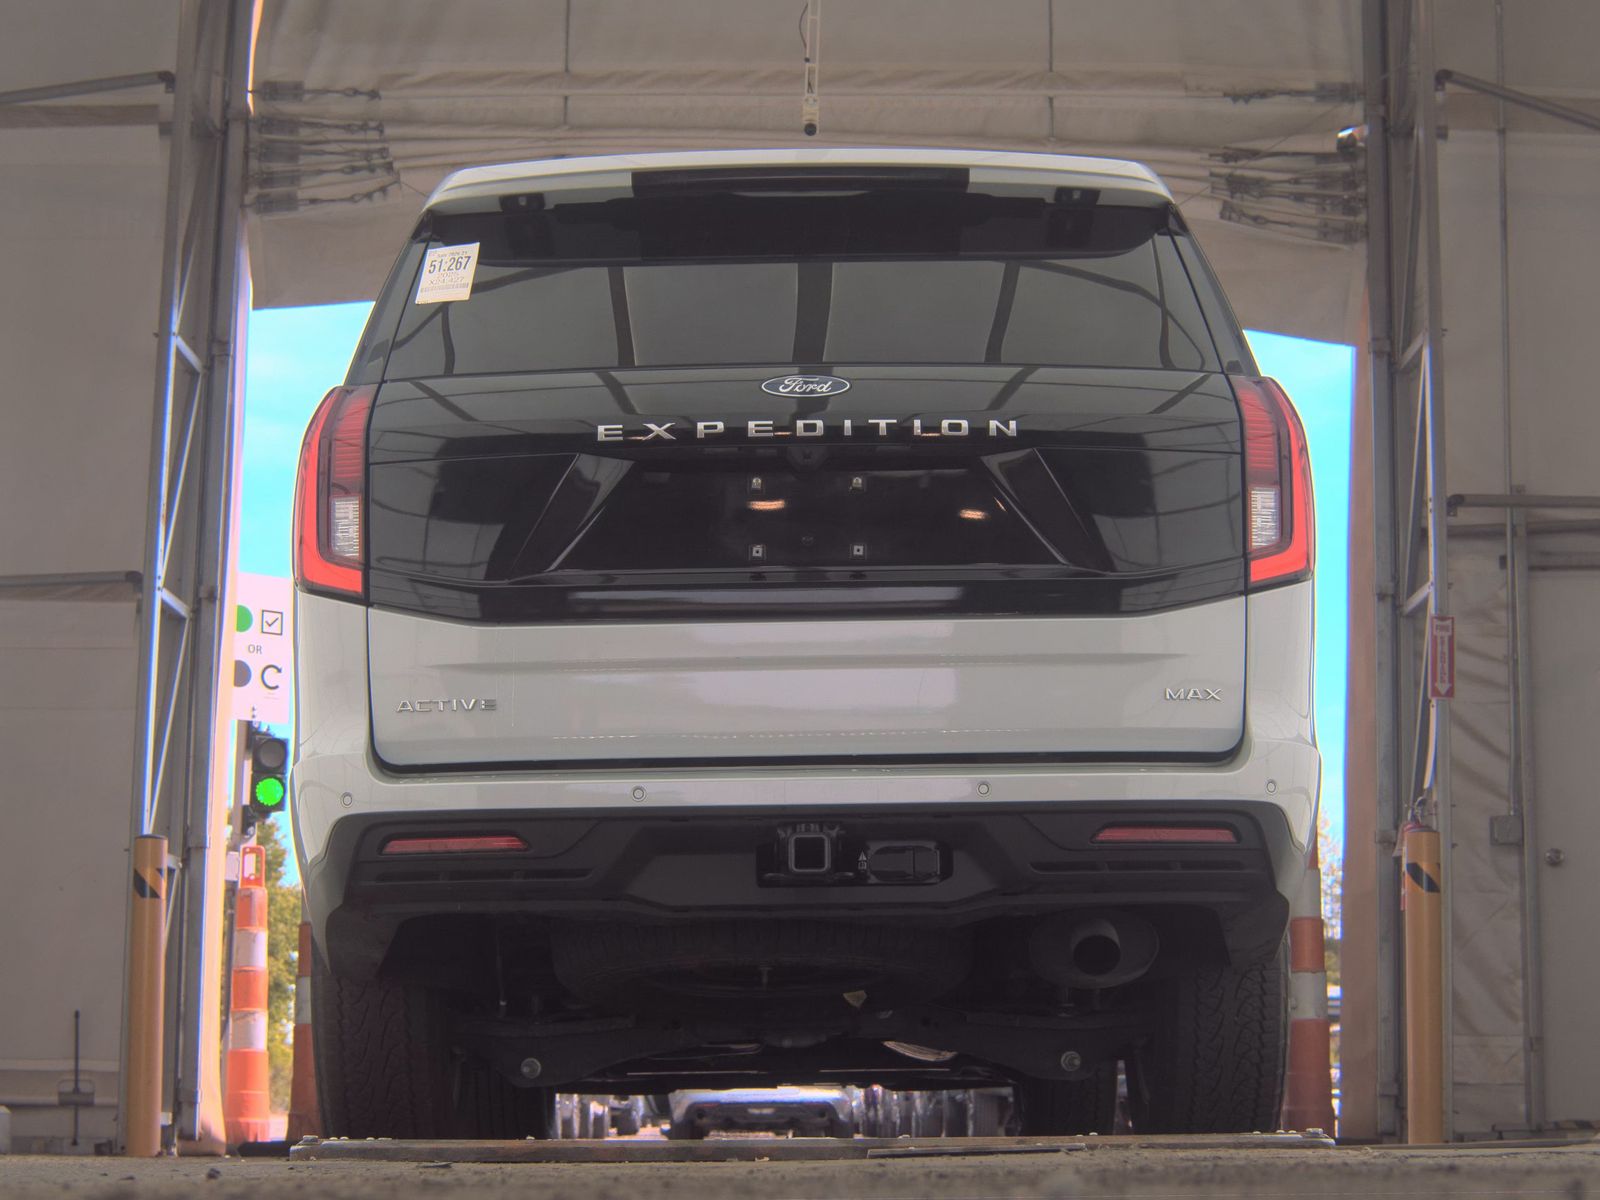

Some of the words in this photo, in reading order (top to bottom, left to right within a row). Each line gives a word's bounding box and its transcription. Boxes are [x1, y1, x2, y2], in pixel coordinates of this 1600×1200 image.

[779, 377, 833, 393] Ford
[597, 418, 1018, 441] EXPEDITION
[247, 643, 263, 655] OR
[1165, 687, 1222, 701] MAX
[396, 699, 497, 713] ACTIVE
